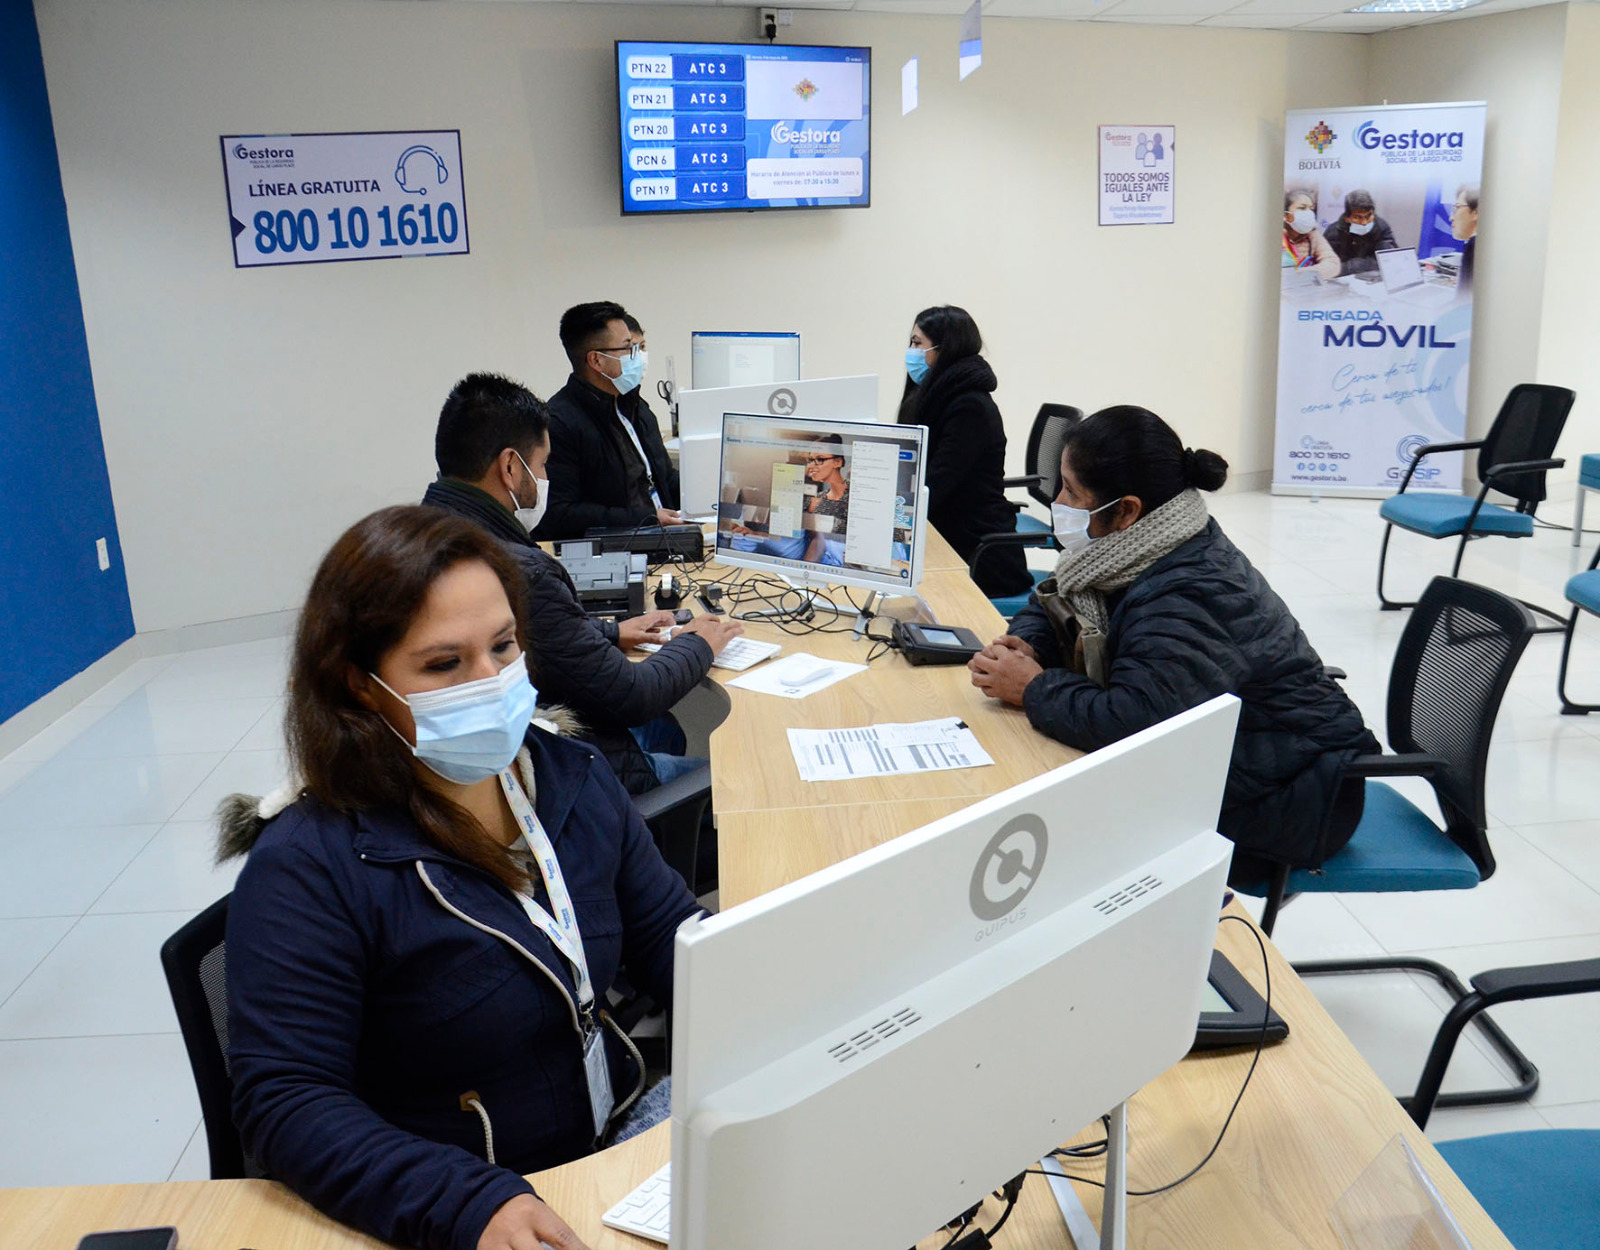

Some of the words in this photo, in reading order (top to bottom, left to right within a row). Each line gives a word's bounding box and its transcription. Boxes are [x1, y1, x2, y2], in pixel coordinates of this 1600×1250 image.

[631, 63, 652, 73] PTN
[655, 63, 667, 73] 22
[689, 62, 716, 74] ATC
[719, 62, 726, 74] 3
[632, 94, 653, 104] PTN
[656, 94, 667, 104] 21
[690, 93, 716, 104] ATC
[720, 93, 727, 104] 3
[633, 125, 654, 135] PTN
[657, 125, 668, 135] 20
[690, 123, 717, 134] ATC
[720, 123, 728, 134] 3
[773, 125, 841, 144] Gestora
[1356, 124, 1463, 150] Gestora
[235, 145, 295, 160] Gestora
[636, 155, 658, 165] PCN
[661, 155, 667, 165] 6
[691, 153, 717, 164] ATC
[721, 153, 728, 163] 3
[1298, 160, 1341, 170] BOLIVIA
[1104, 173, 1135, 182] TODOS
[1137, 172, 1170, 182] SOMOS
[249, 179, 298, 197] LÍNEA
[301, 179, 381, 196] GRATUITA
[635, 185, 656, 195] PTN
[659, 185, 670, 195] 19
[692, 182, 718, 193] ATC
[722, 182, 729, 193] 3
[1105, 183, 1144, 193] IGUALES
[1145, 182, 1169, 192] ANTE
[1122, 193, 1134, 203] LA
[1136, 193, 1152, 202] LEY
[253, 208, 320, 254] 800
[327, 206, 370, 249] 10
[377, 202, 459, 246] 1610
[1298, 310, 1384, 321] BRIGADA
[1323, 320, 1456, 348] MÓVIL
[1332, 363, 1378, 392] Cerca
[1288, 451, 1312, 459] 800
[1327, 452, 1350, 460] 1610
[974, 907, 1027, 942] QUIPUS
